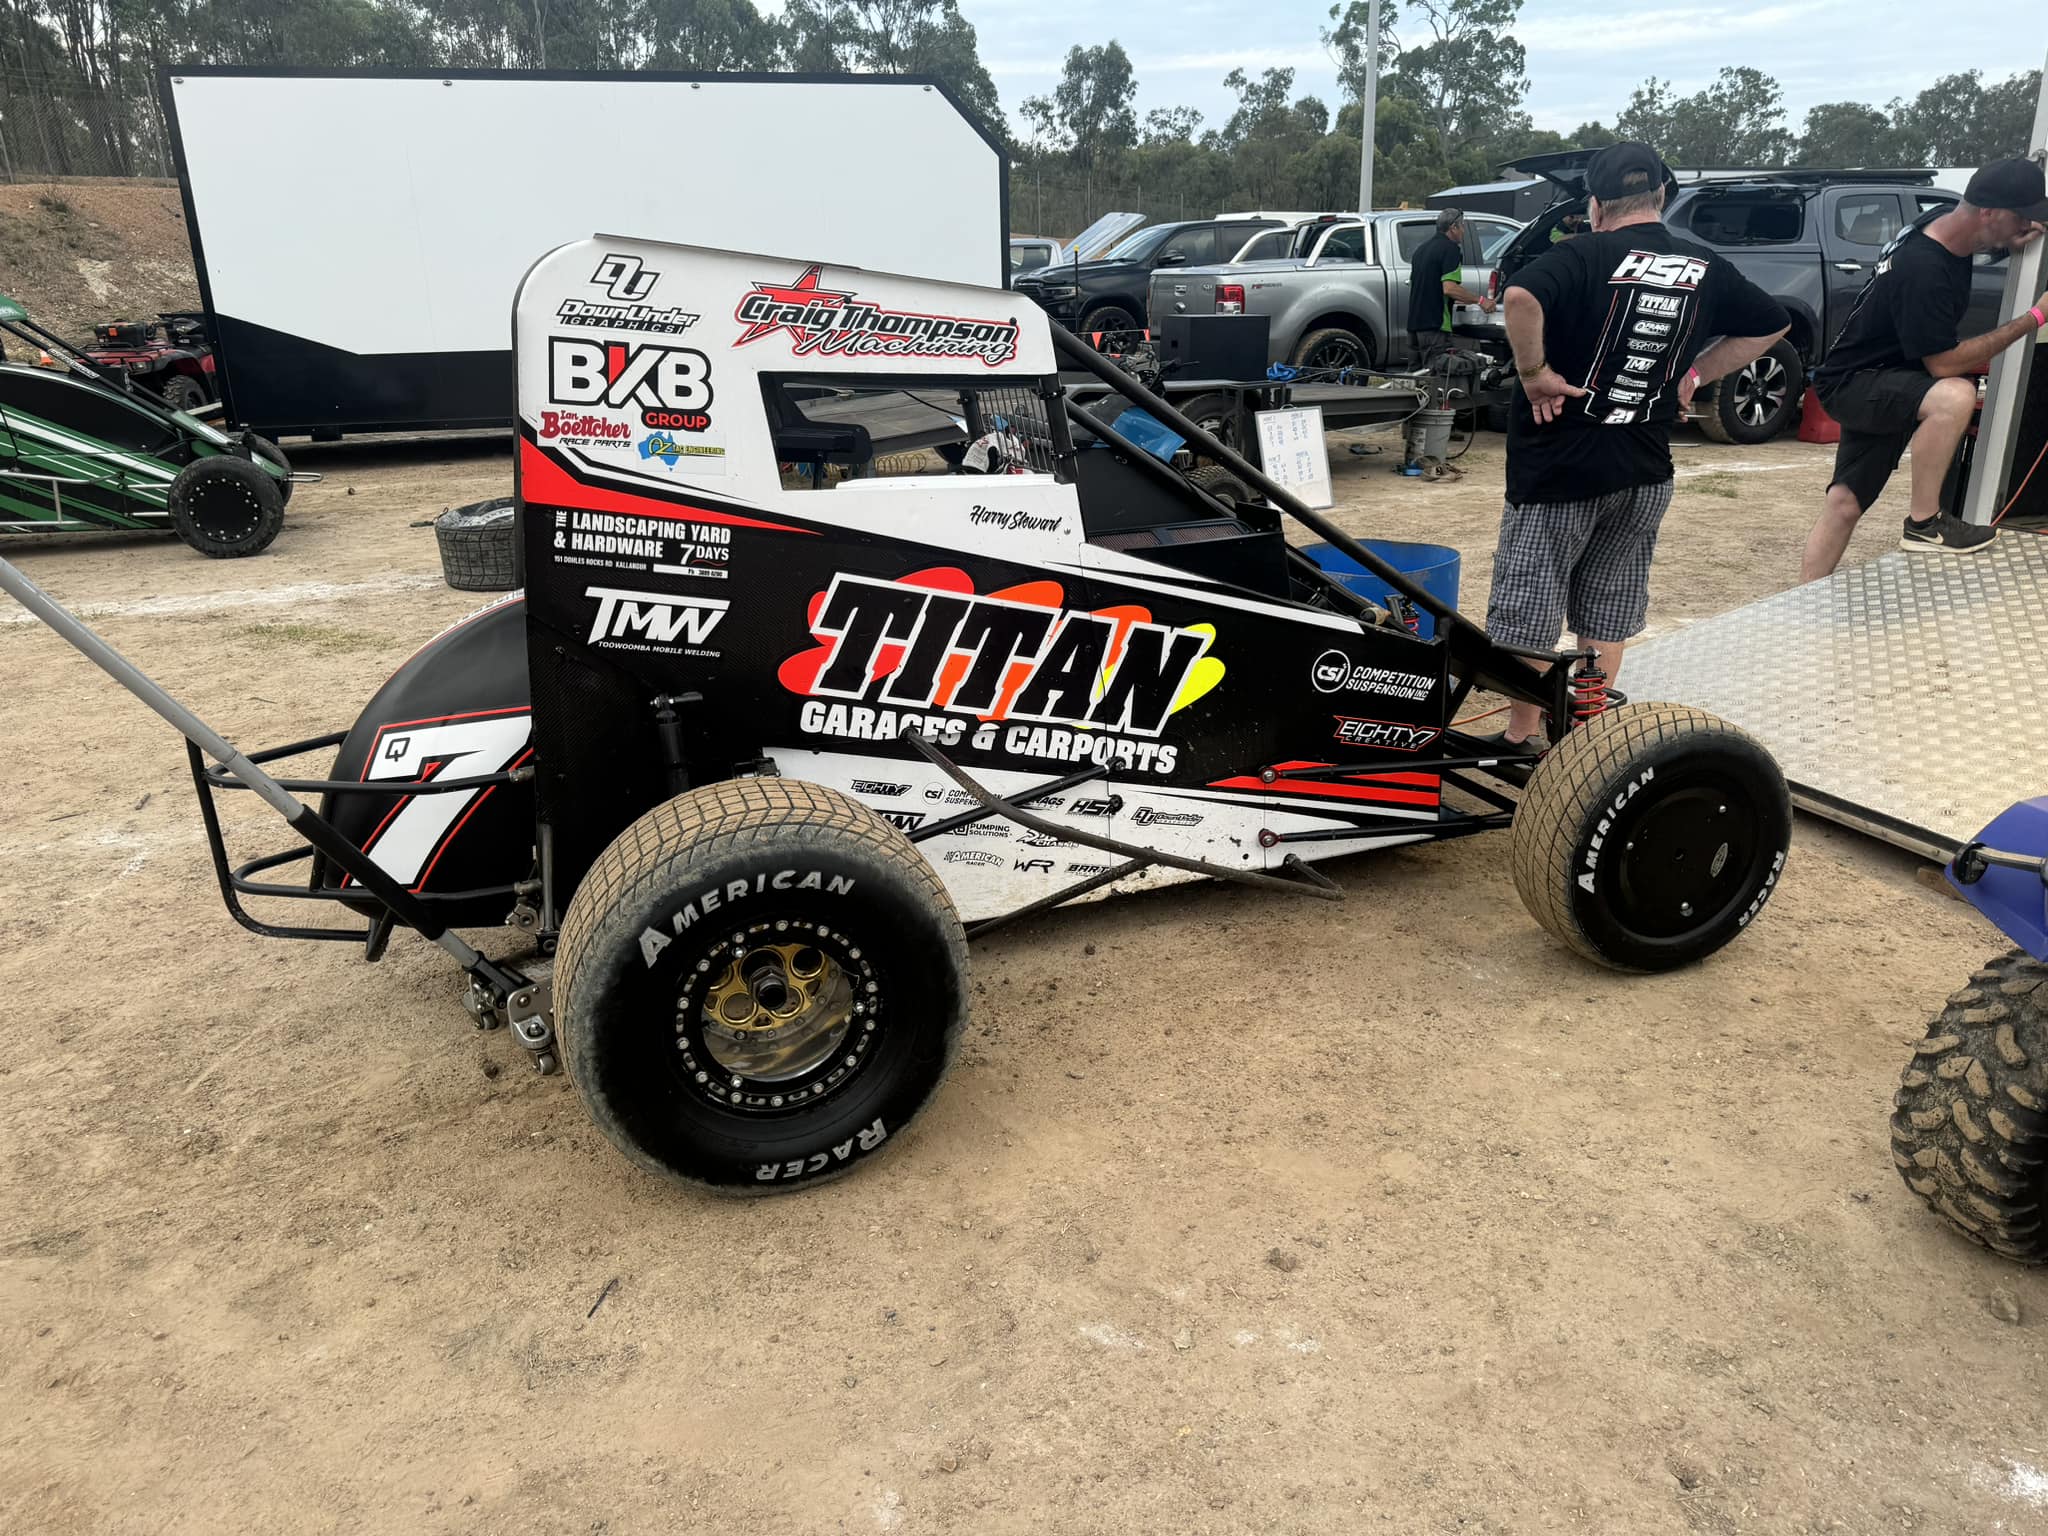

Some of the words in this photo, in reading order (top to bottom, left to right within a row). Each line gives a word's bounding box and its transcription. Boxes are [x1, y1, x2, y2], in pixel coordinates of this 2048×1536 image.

[1610, 253, 1707, 287] HSR
[1640, 294, 1679, 311] TITAN
[570, 316, 676, 334] GRAPHICS
[738, 294, 838, 333] Craig
[839, 300, 1018, 343] Thompson
[797, 329, 1015, 365] Machining
[549, 335, 714, 411] BKB
[540, 411, 632, 439] Boettcher
[560, 410, 578, 420] Ian
[645, 411, 708, 429] GROUP
[559, 437, 591, 446] RACE
[593, 439, 632, 449] PARTS
[555, 510, 567, 528] THE
[572, 512, 686, 540] LANDSCAPING
[691, 524, 732, 545] YARD
[970, 505, 1012, 530] Harry
[1008, 511, 1062, 532] Stewart
[554, 531, 566, 549] &
[571, 532, 664, 559] HARDWARE
[680, 543, 695, 565] 7
[696, 545, 730, 561] DAYS
[586, 558, 604, 567] ROCKS
[585, 586, 730, 646] TMW
[598, 641, 651, 652] TOOWOOMBA
[653, 645, 682, 655] MOBILE
[684, 648, 721, 658] WELDING
[809, 571, 1213, 738] TITAN
[1345, 678, 1415, 699] SUSPENSION
[1414, 689, 1429, 699] INC
[1352, 665, 1437, 691] COMPETITION
[1339, 720, 1436, 745] EIGHTY7
[1345, 735, 1417, 749] CREATIVE
[1005, 725, 1179, 774] CARPORTS
[969, 829, 1009, 838] SOLUTIONS
[970, 823, 1010, 832] PUMPING
[1577, 766, 1656, 894] AMERICAN
[949, 850, 1005, 867] AMERICAN
[1738, 850, 1786, 927] RACER
[638, 869, 856, 969] AMERICAN
[755, 1117, 889, 1181] RACER
